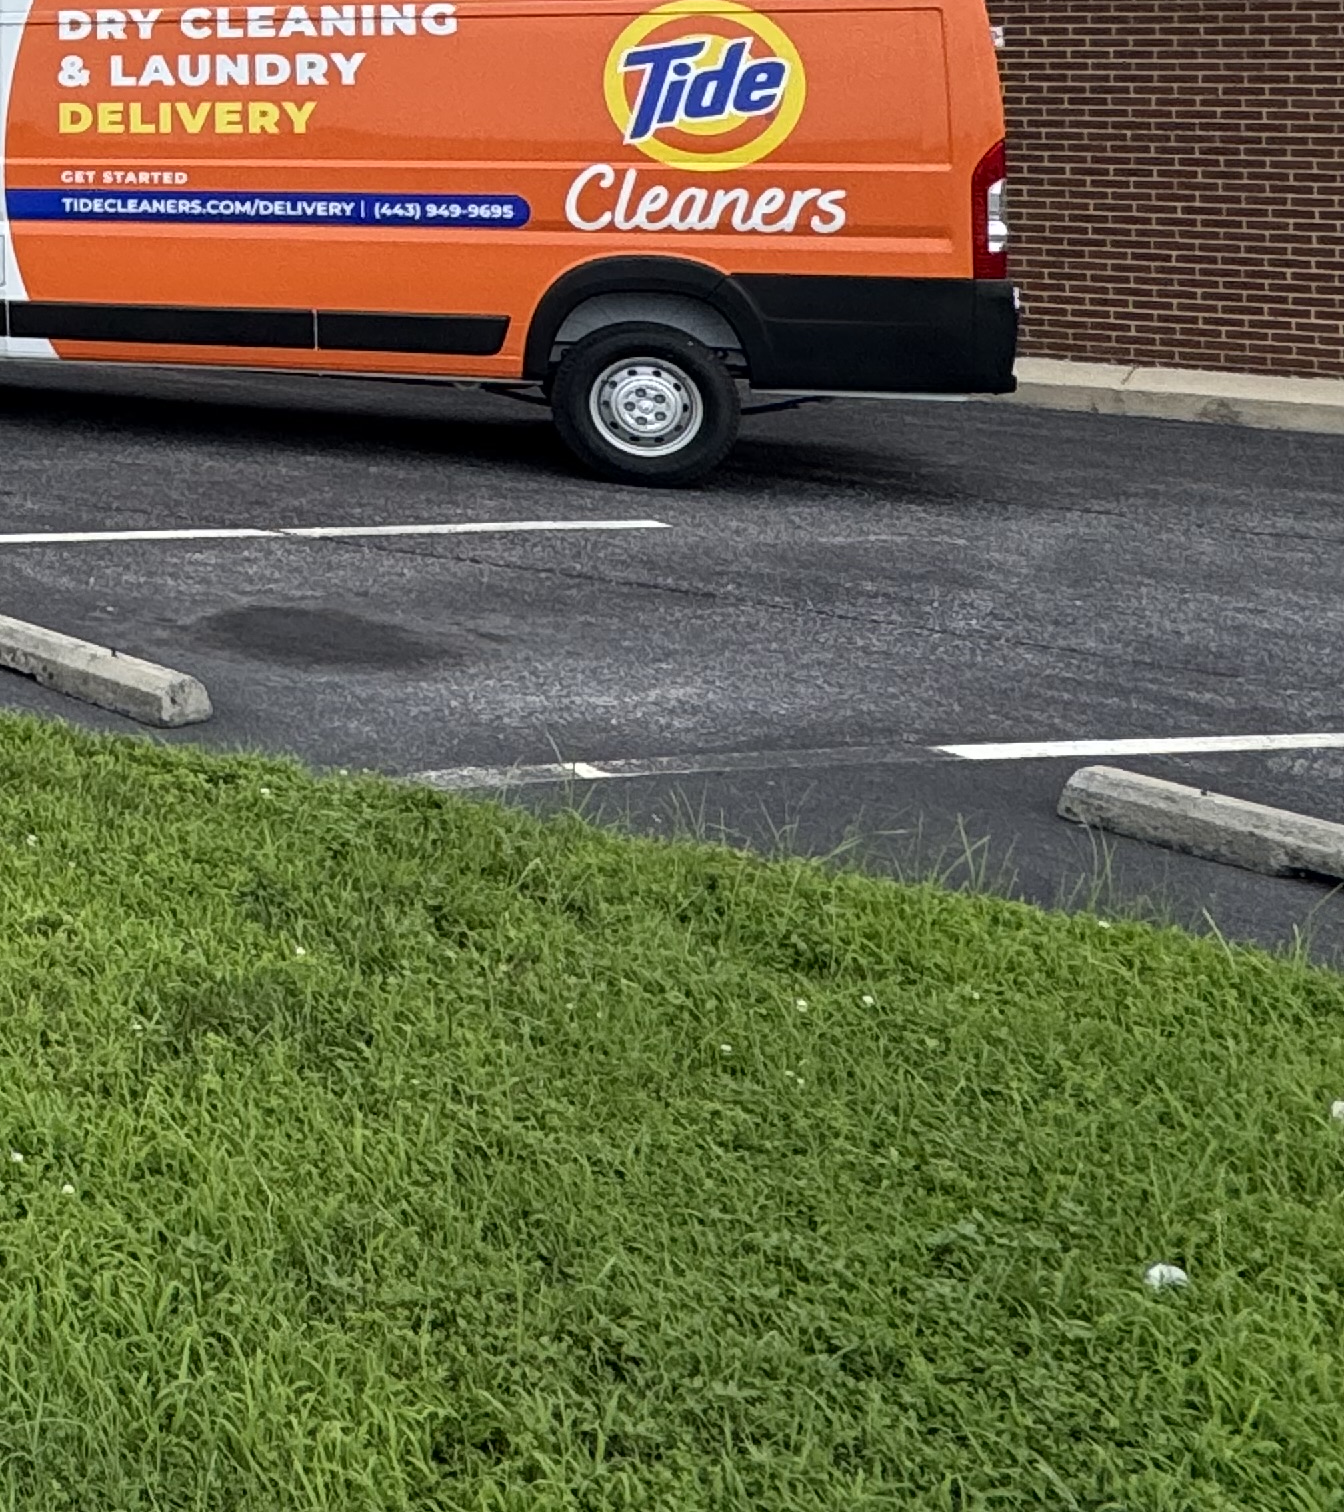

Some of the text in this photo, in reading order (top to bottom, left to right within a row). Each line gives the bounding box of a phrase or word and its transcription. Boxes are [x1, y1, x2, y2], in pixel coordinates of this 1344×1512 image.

[57, 3, 458, 40] DRY CLEANING
[57, 52, 367, 87] & LAUNDRY
[617, 37, 789, 145] Tide
[58, 101, 318, 134] DELIVERY
[60, 169, 188, 185] GET STARTED
[61, 196, 355, 217] TIDECLEANERS.COM/DELIVERY
[373, 201, 421, 220] (443)
[425, 202, 515, 220] 949-9695
[564, 164, 847, 233] Cleaners
